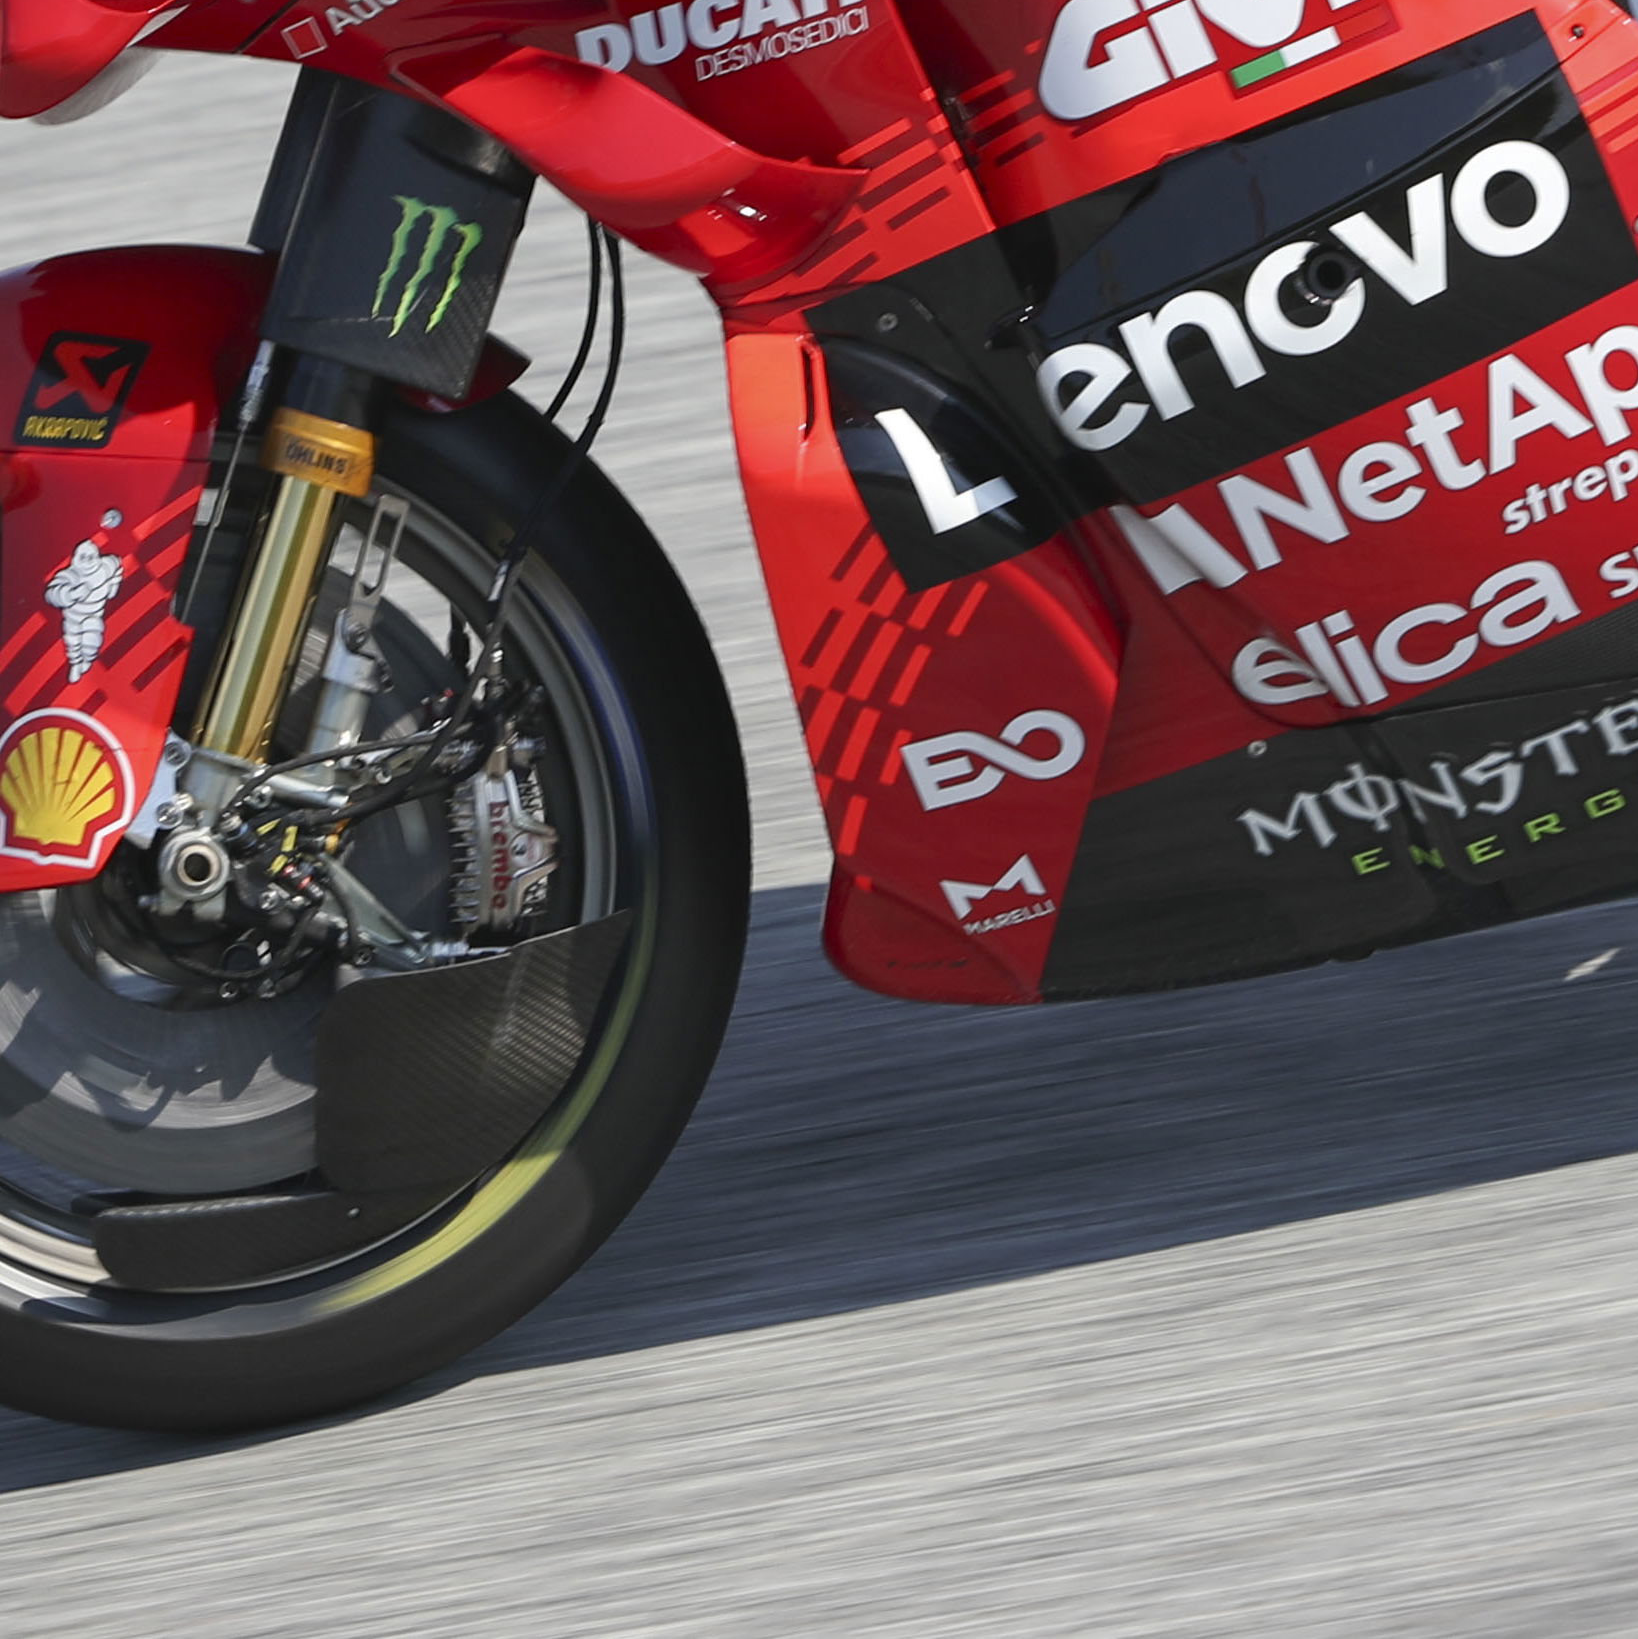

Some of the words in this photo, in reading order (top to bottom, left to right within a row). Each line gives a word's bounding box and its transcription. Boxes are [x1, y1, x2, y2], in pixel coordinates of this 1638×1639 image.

[695, 5, 869, 82] DESMOSEDICI
[1231, 559, 1582, 708] elica
[962, 899, 1056, 936] MARELLI
